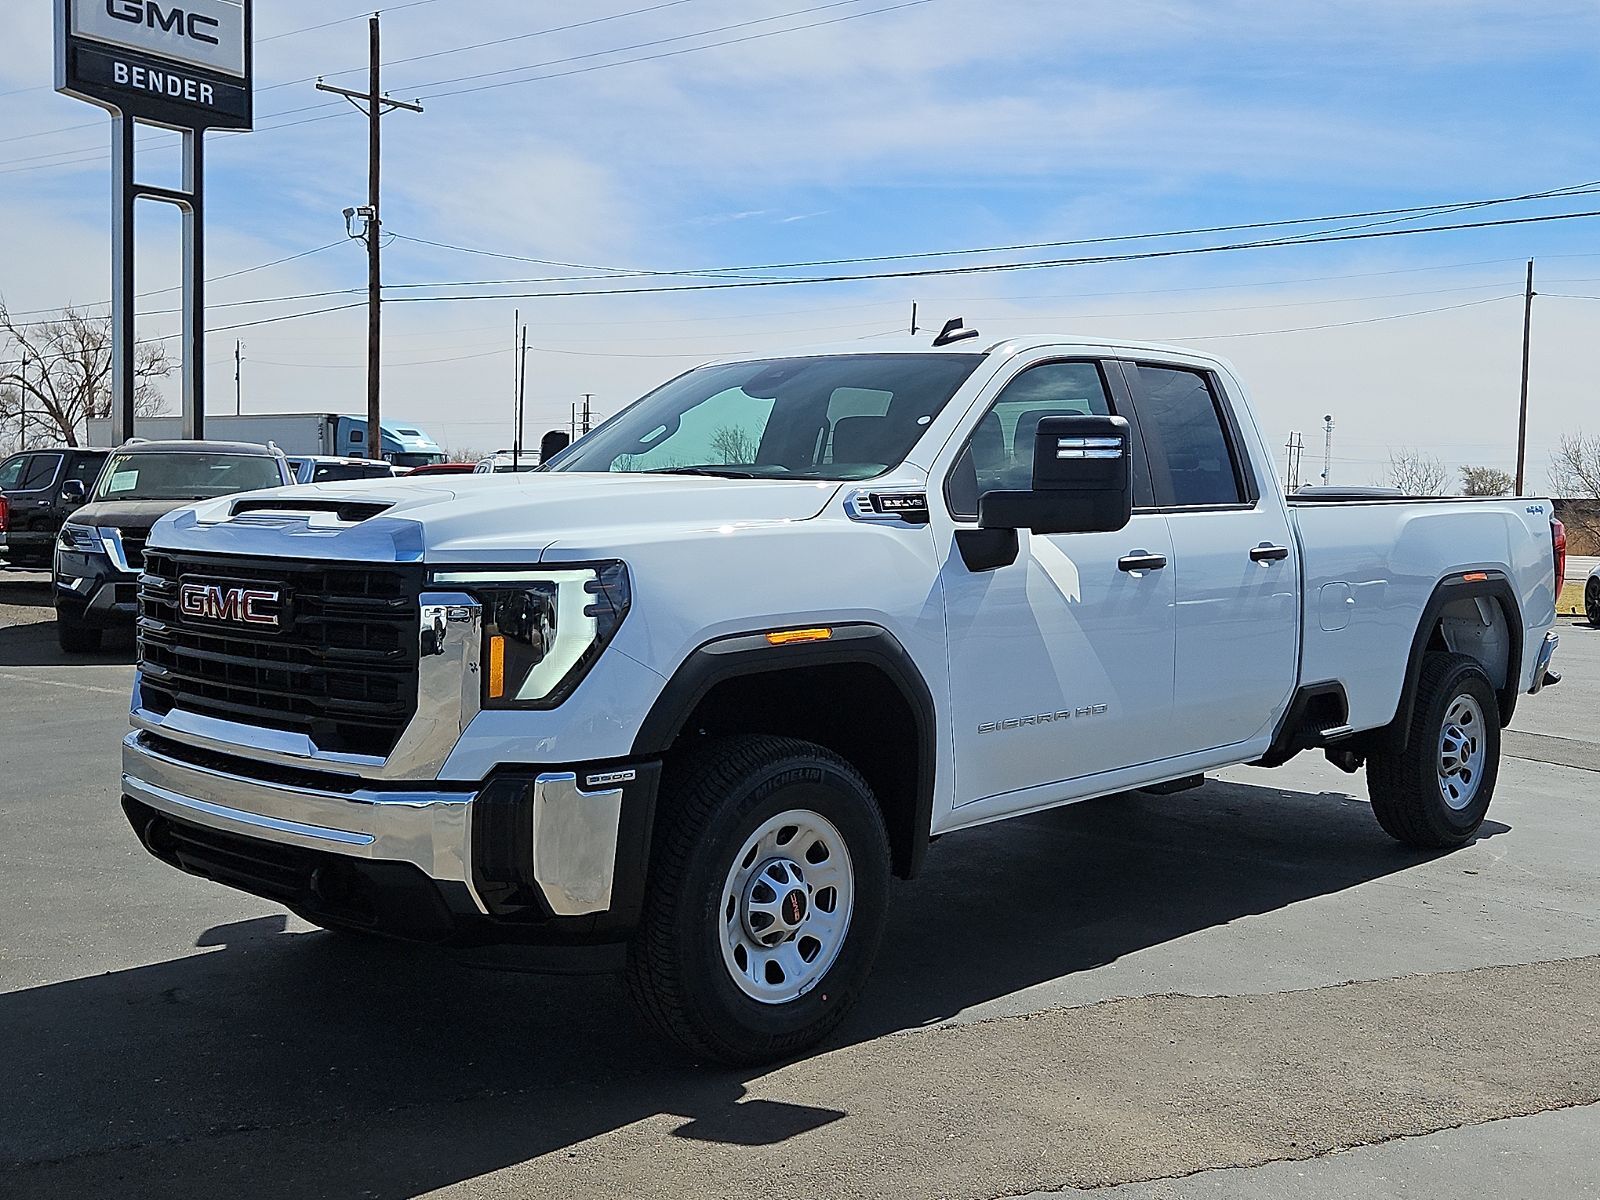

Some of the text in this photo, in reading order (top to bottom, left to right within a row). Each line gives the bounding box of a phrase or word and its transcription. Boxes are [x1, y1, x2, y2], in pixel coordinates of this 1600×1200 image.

[106, 0, 219, 45] GMC
[113, 61, 214, 105] BENDER
[180, 583, 279, 625] GMC
[977, 703, 1108, 735] SIERRA HD
[752, 767, 821, 802] MICHELIN
[790, 892, 800, 922] GMC
